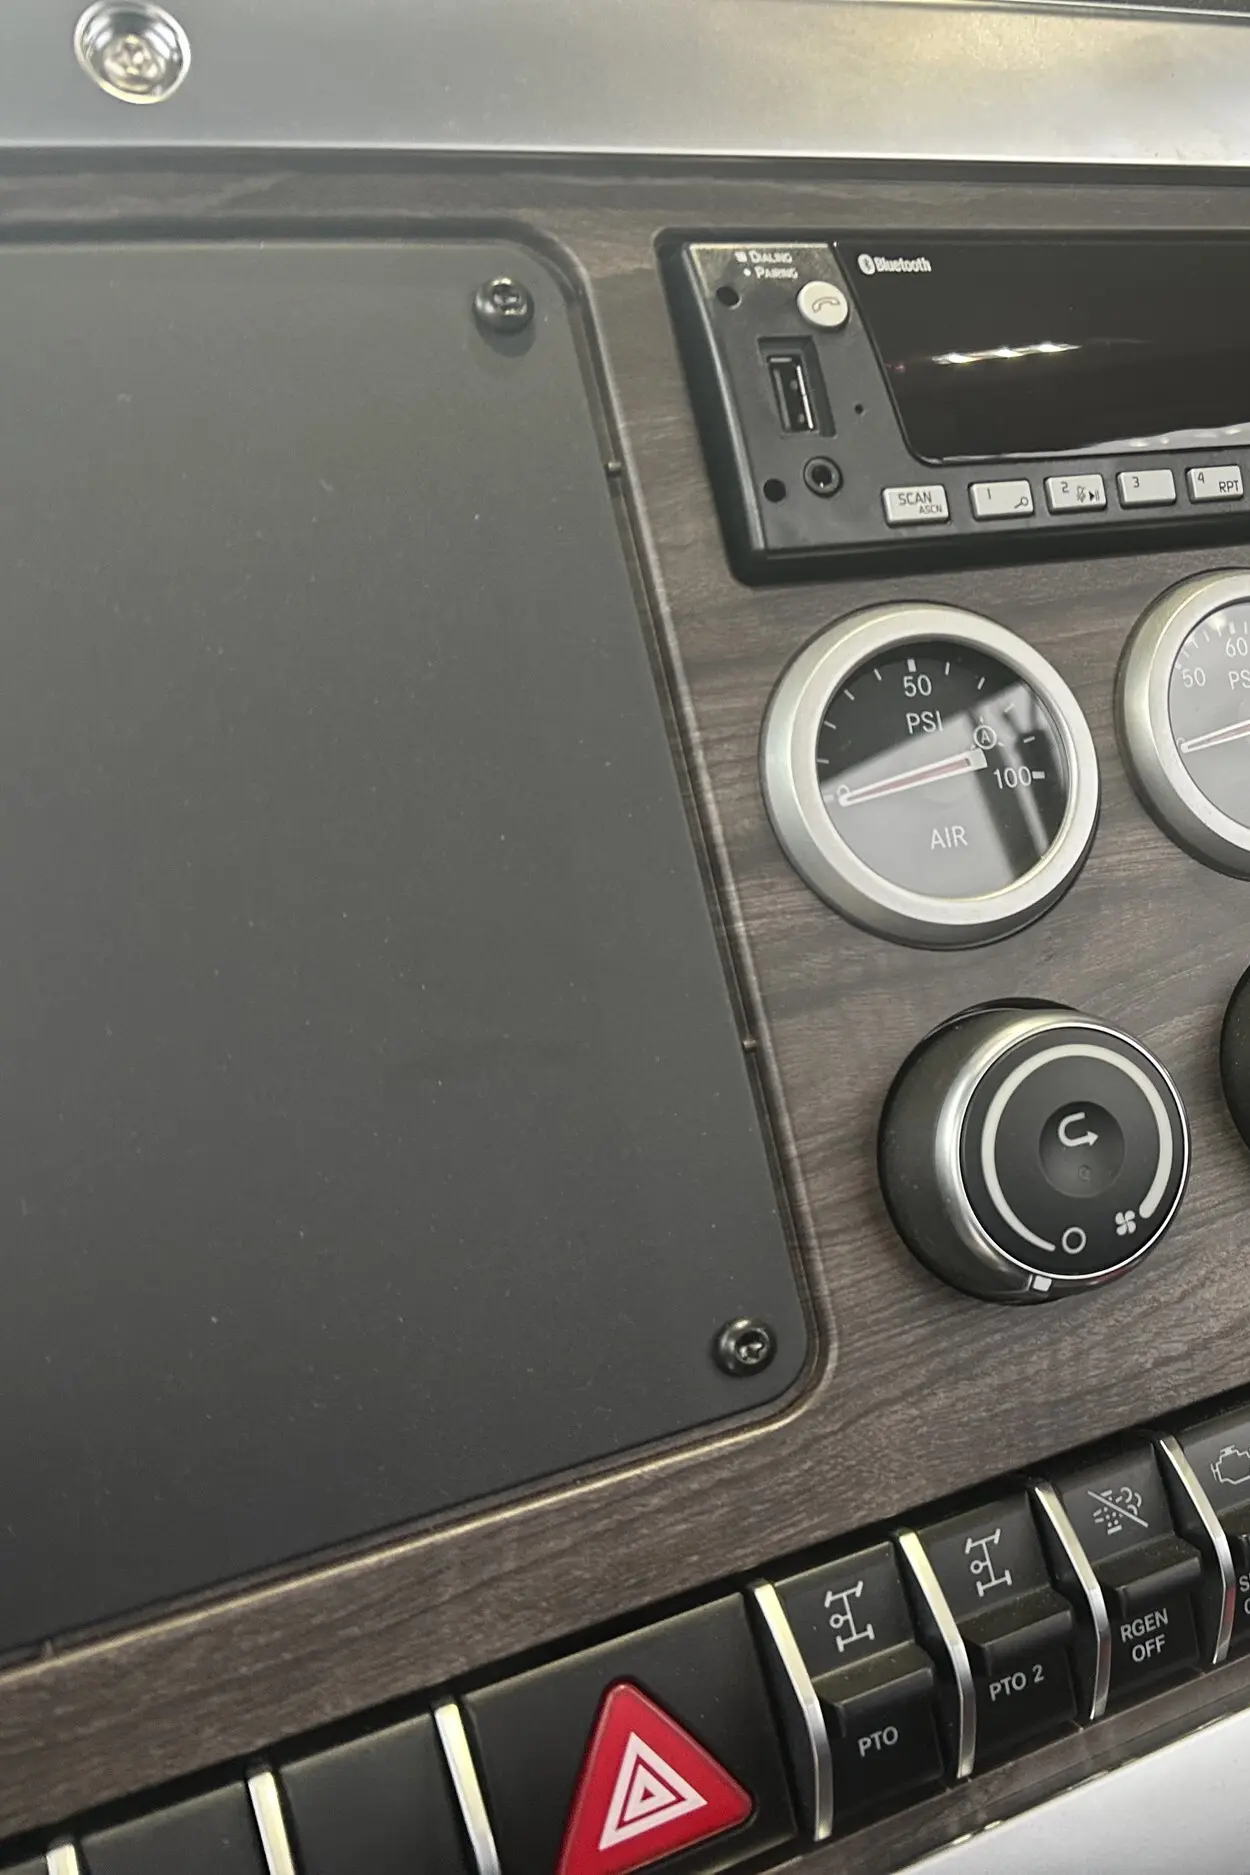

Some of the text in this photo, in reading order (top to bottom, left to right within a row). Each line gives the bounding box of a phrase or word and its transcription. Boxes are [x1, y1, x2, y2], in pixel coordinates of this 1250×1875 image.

[874, 256, 932, 273] Bluetooth
[1061, 481, 1070, 493] 2
[1132, 477, 1141, 488] 3
[1197, 471, 1205, 484] 4
[1218, 480, 1240, 493] RPT
[898, 492, 932, 505] SCAN
[919, 504, 943, 515] ASCN
[1225, 637, 1248, 658] 60
[903, 675, 932, 697] 50
[1181, 667, 1206, 688] 50
[905, 711, 943, 734] PSI
[993, 766, 1032, 789] 100
[930, 825, 968, 850] AIR
[1119, 1607, 1170, 1643] RGEN
[1130, 1633, 1167, 1663] OFF
[989, 1663, 1046, 1701] PTO 2
[857, 1726, 899, 1757] PTO
